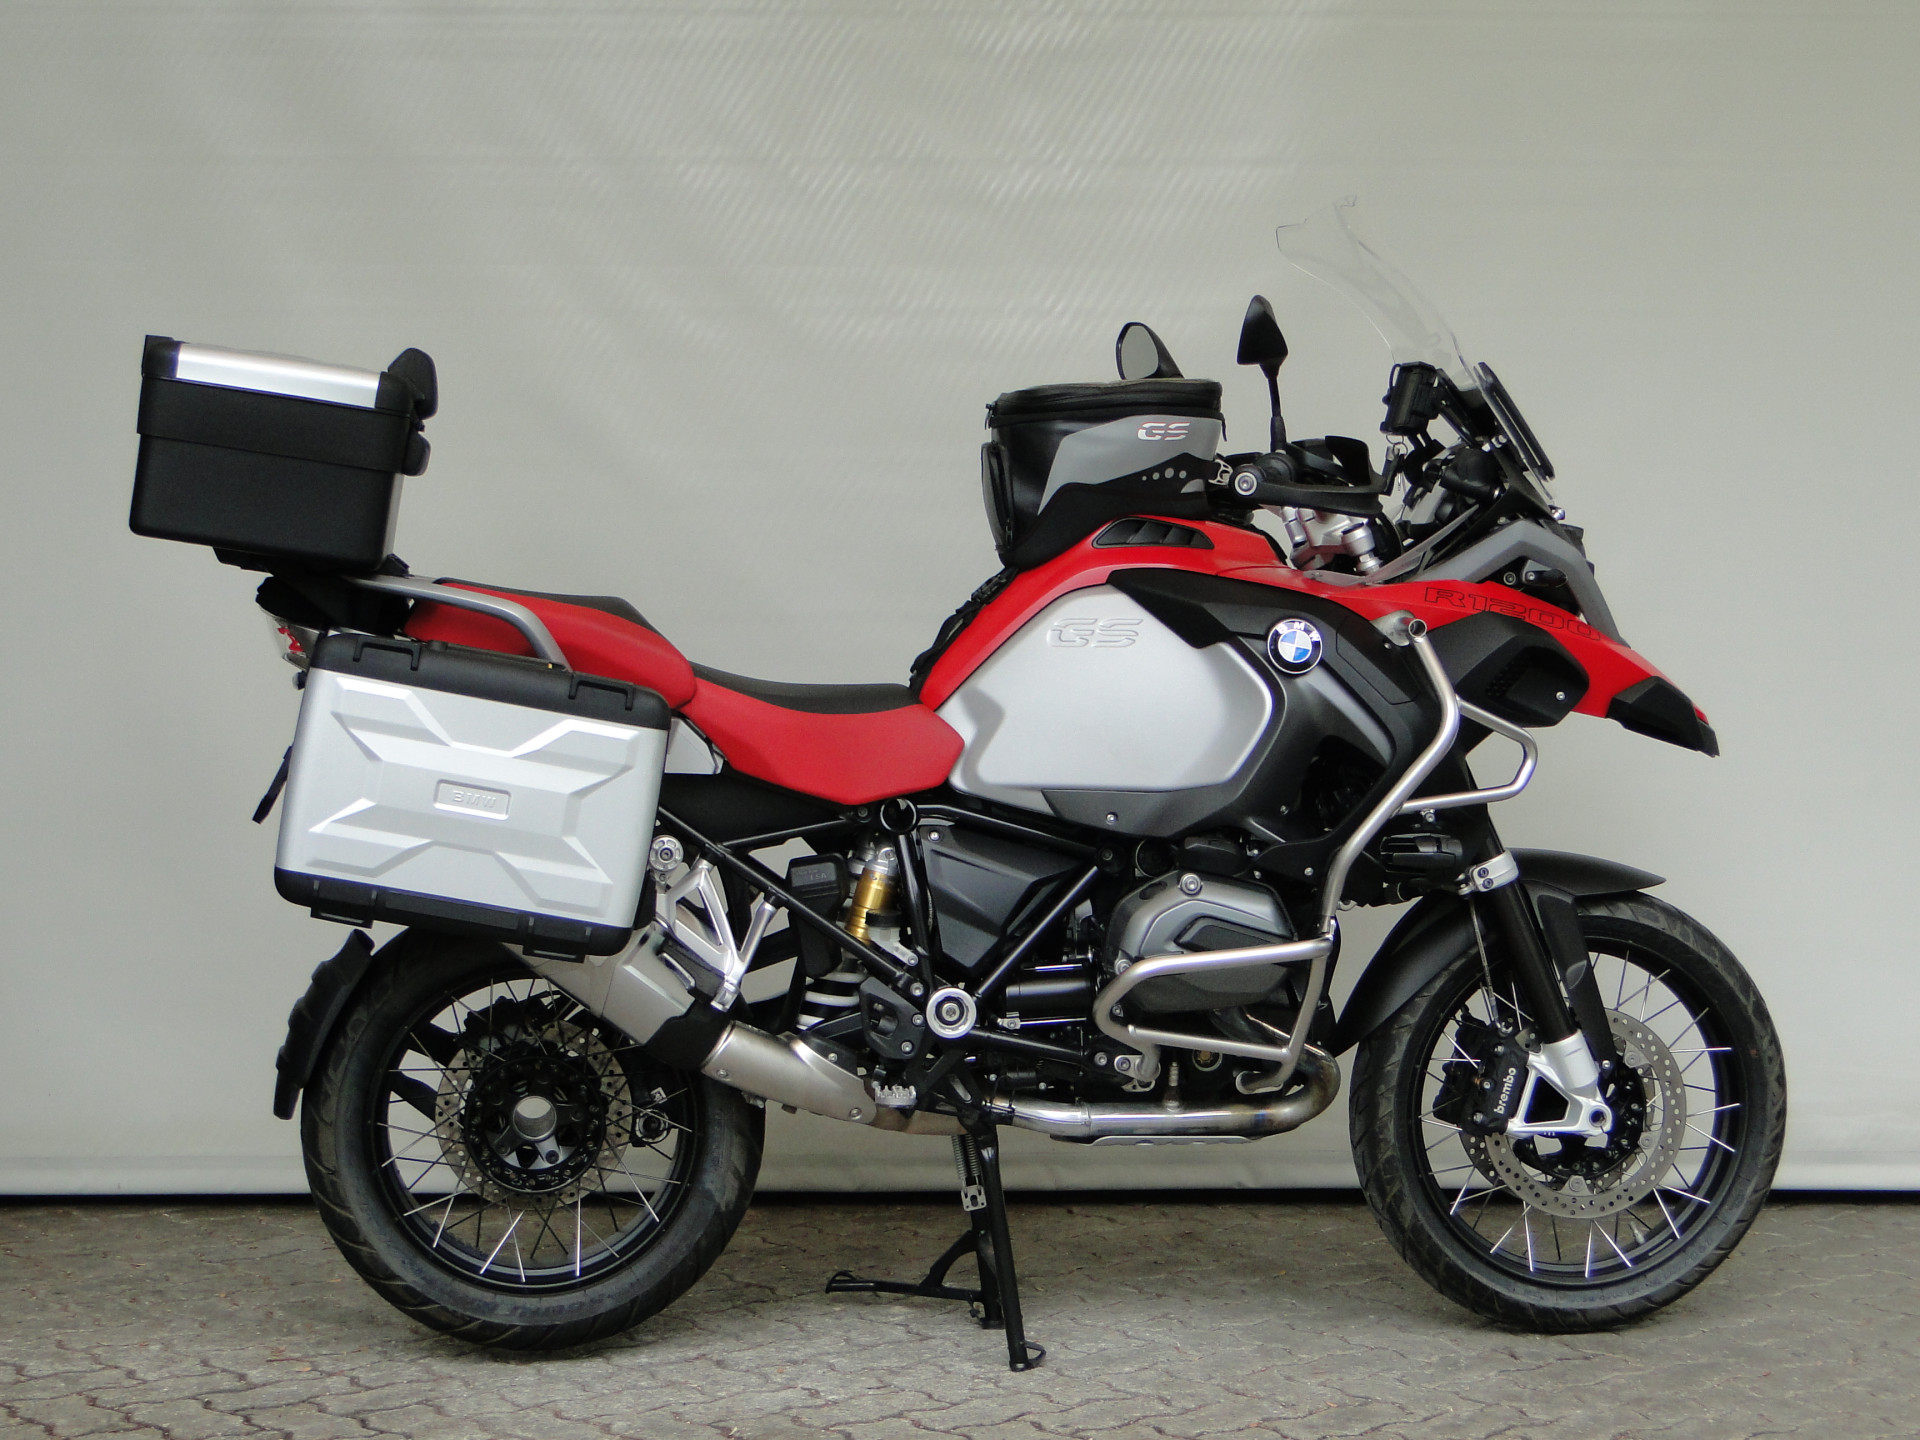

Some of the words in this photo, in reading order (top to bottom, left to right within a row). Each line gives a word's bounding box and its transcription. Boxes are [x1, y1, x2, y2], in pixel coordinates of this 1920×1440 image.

[1137, 422, 1191, 441] GS
[1046, 618, 1144, 648] GS
[1275, 621, 1321, 642] BMW
[453, 790, 497, 808] BMW
[1493, 1067, 1517, 1115] brembo
